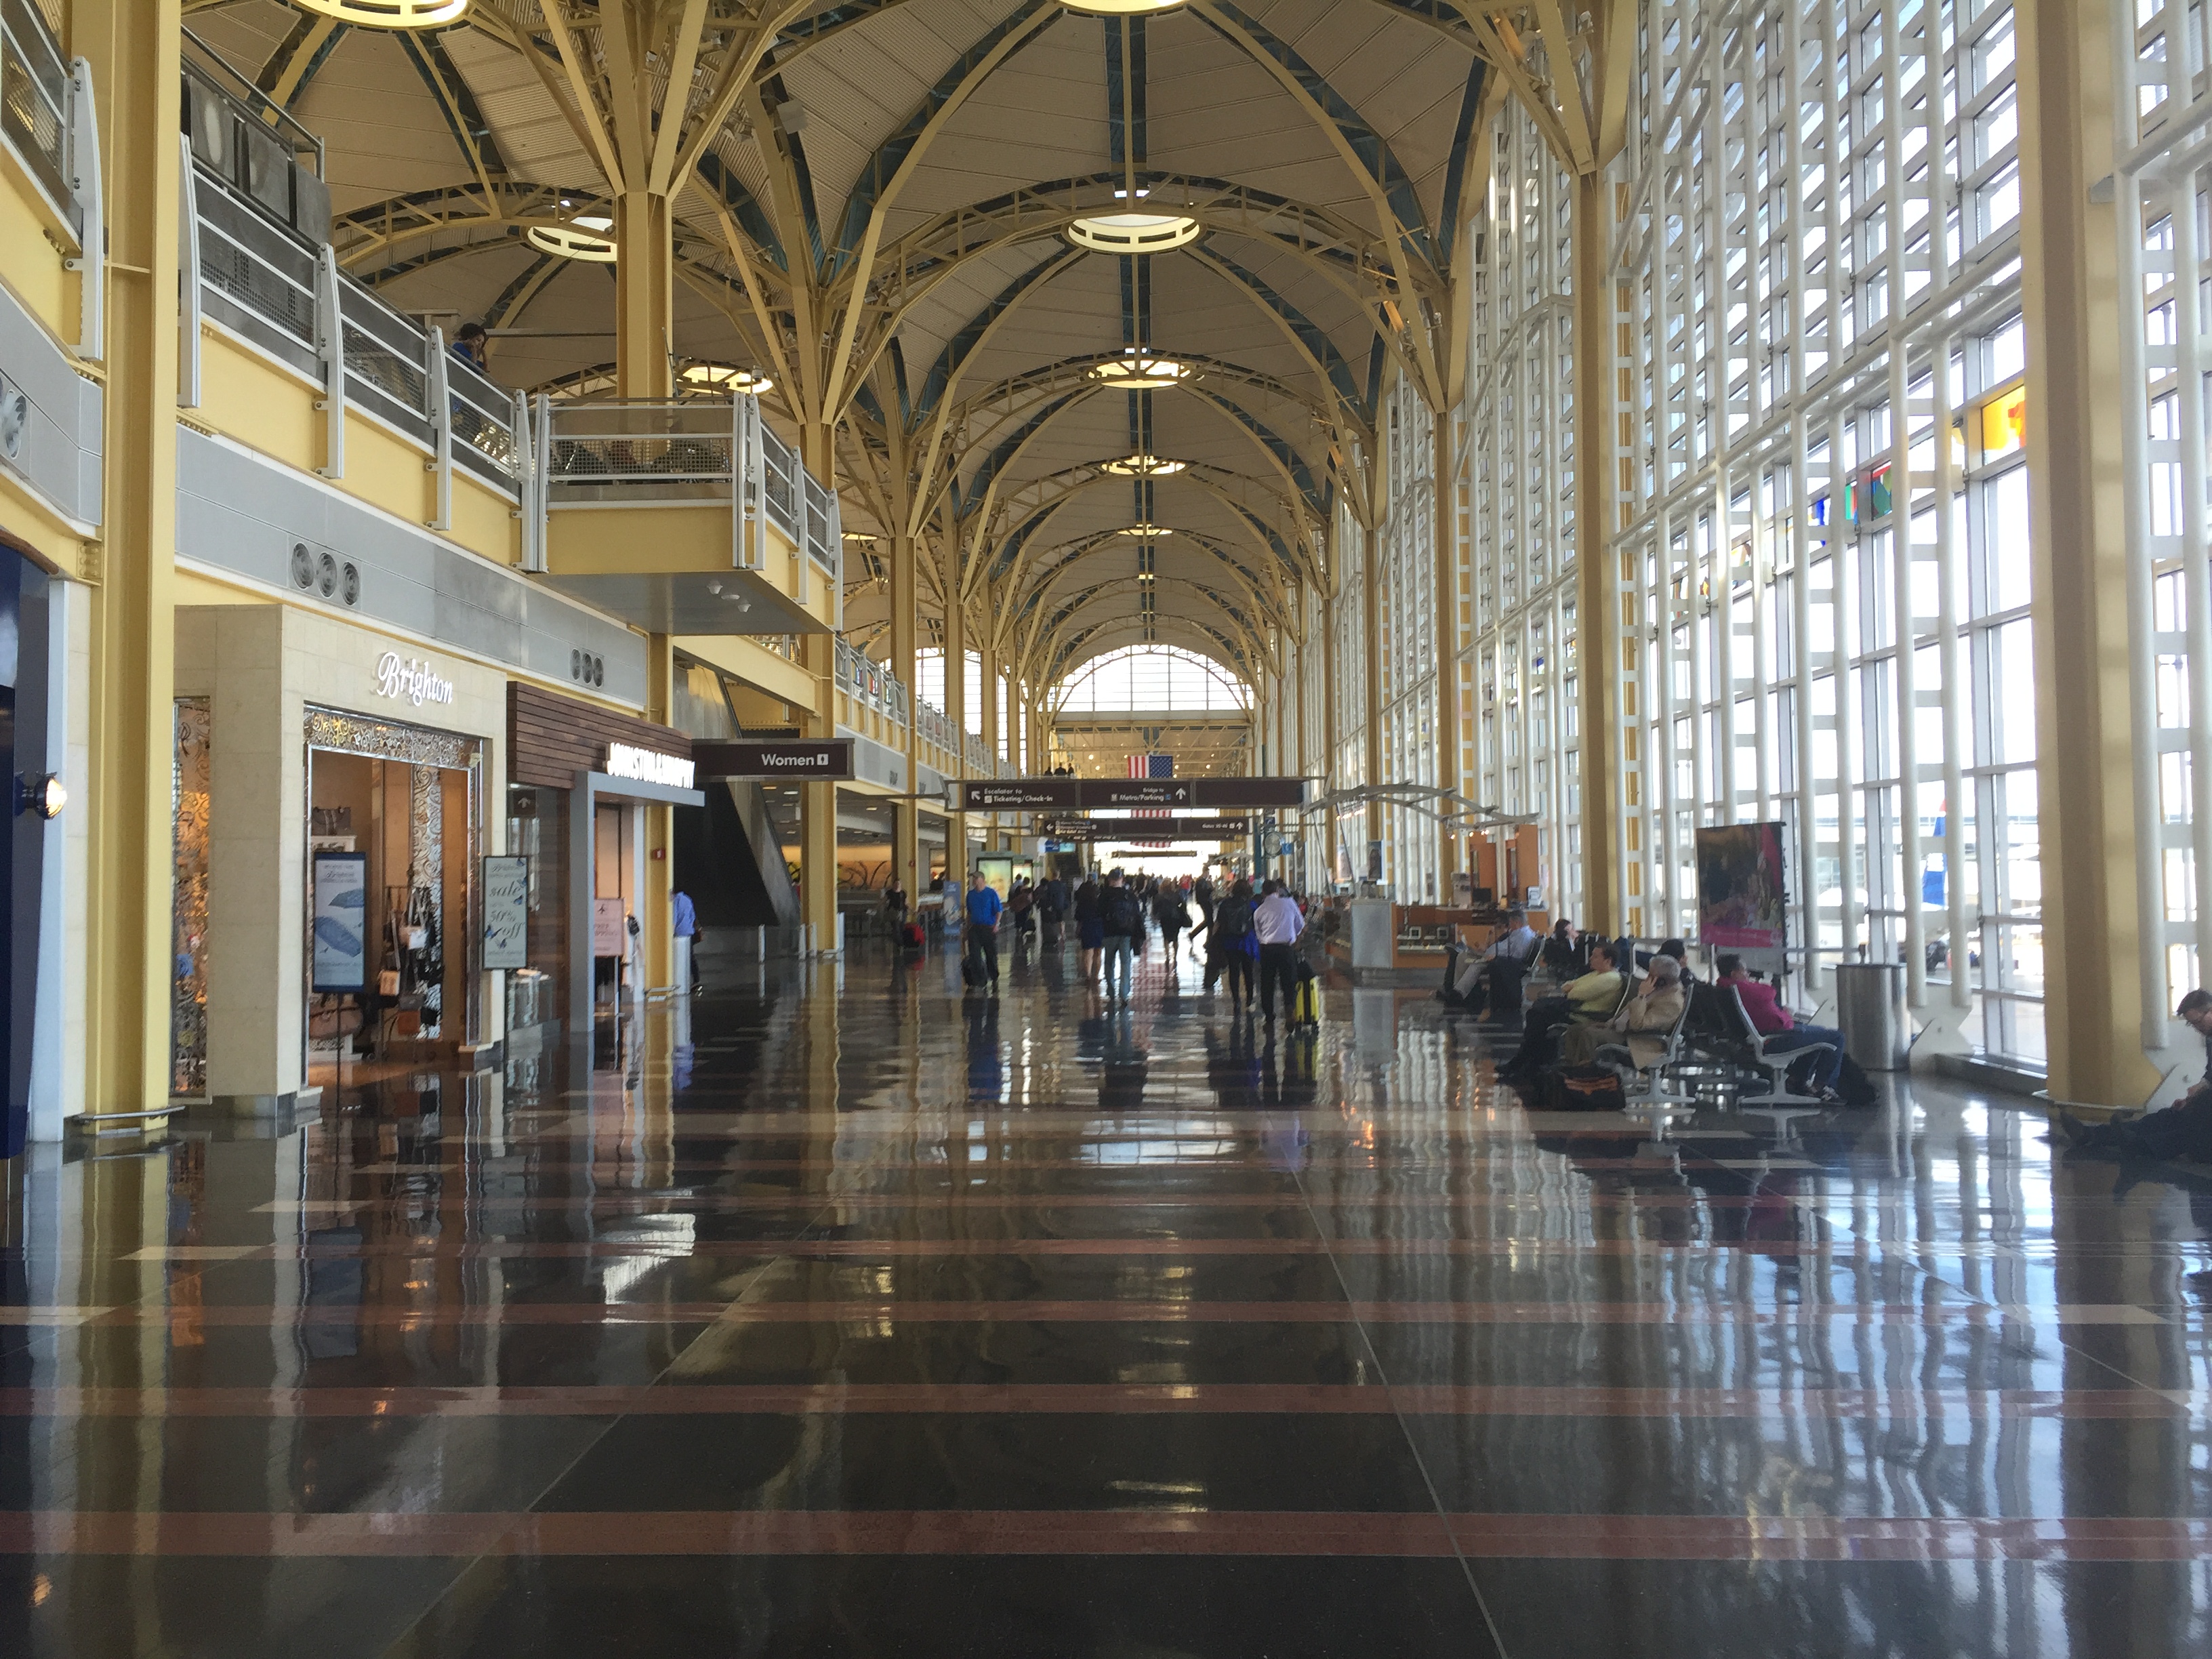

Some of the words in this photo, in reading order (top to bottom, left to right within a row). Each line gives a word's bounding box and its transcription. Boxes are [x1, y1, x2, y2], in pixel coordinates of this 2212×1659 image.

[377, 651, 453, 706] Brighton
[761, 753, 815, 766] Women
[1119, 794, 1164, 802] Metro/Parking
[489, 881, 521, 897] sale
[490, 909, 517, 923] 50%
[501, 922, 525, 940] off
